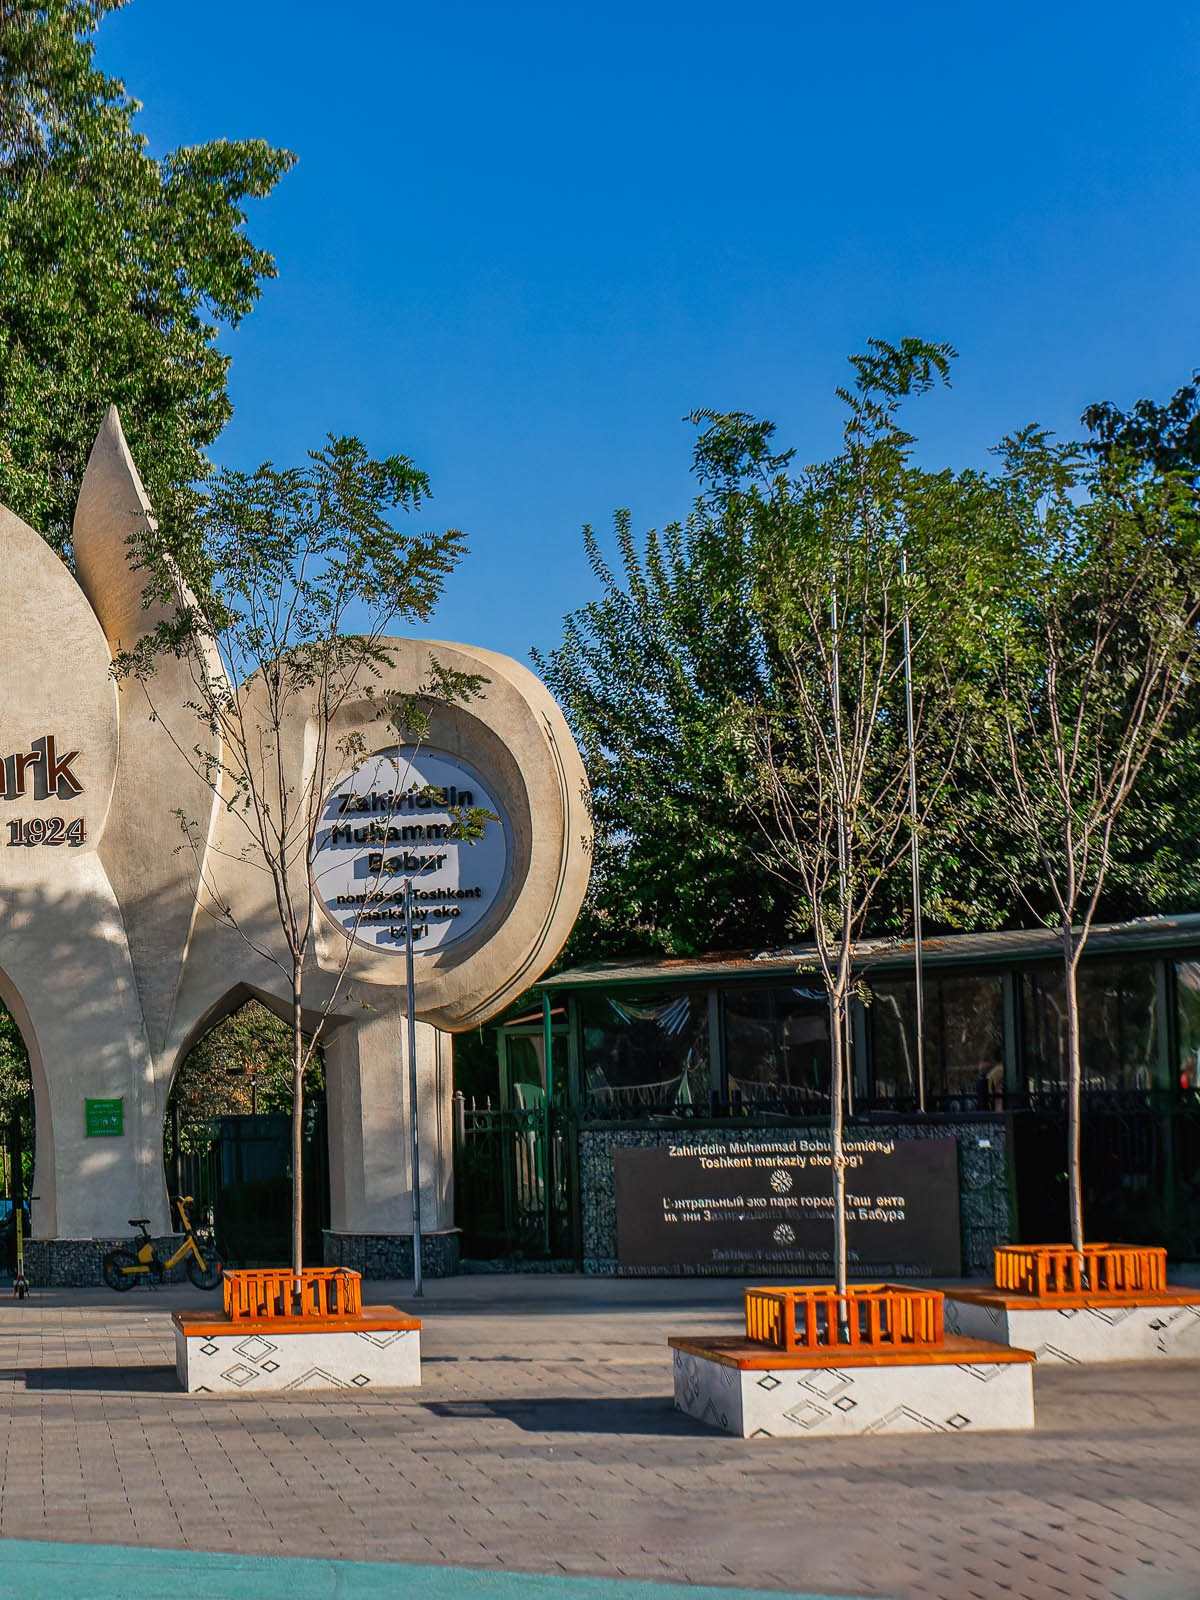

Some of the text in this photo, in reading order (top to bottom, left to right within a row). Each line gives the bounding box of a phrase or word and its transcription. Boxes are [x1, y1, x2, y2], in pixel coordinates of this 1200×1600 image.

[10, 817, 87, 846] 1924
[368, 851, 448, 873] Bobur
[411, 887, 481, 900] Toshkent
[433, 906, 461, 918] eko
[669, 1143, 727, 1157] Zahiriddin
[730, 1140, 797, 1154] Muhammad
[800, 1139, 832, 1153] Bobu
[700, 1156, 753, 1169] Toshkent
[755, 1154, 807, 1168] markaziy
[810, 1154, 832, 1166] eko
[747, 1198, 767, 1208] эко
[769, 1197, 798, 1209] парк
[846, 1194, 905, 1207] Ташента
[858, 1207, 905, 1223] Бабура
